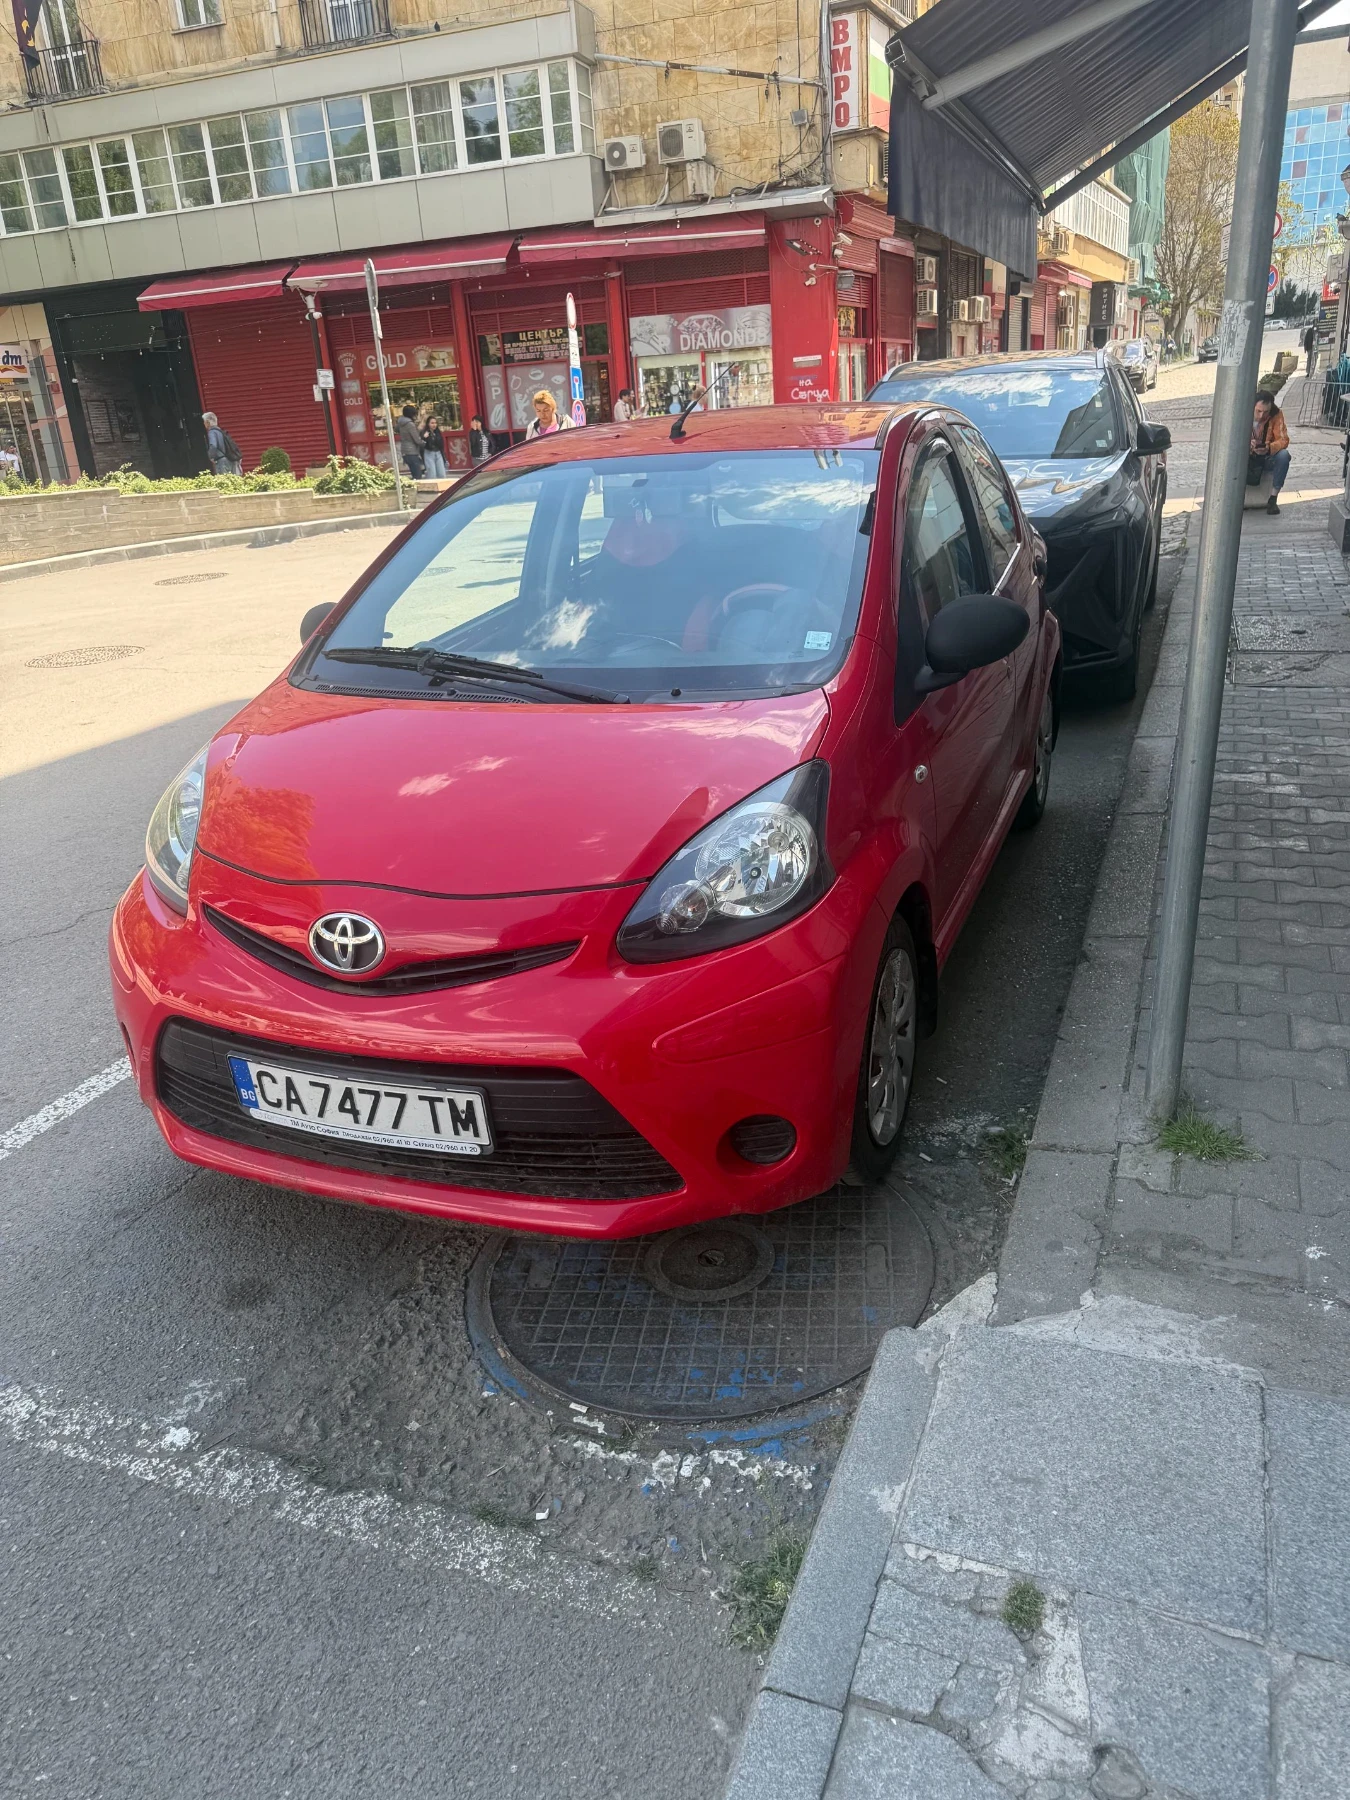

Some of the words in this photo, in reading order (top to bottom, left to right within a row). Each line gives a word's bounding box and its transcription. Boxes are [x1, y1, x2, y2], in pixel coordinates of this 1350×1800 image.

[831, 18, 852, 128] ВМРО
[519, 328, 563, 342] ЦЕНТЪР
[680, 326, 767, 351] DIAMONDS
[2, 350, 22, 365] dm
[366, 352, 407, 370] GOLD
[344, 367, 354, 379] P
[491, 387, 501, 400] P
[343, 397, 363, 406] GOLD
[240, 1088, 256, 1102] BG
